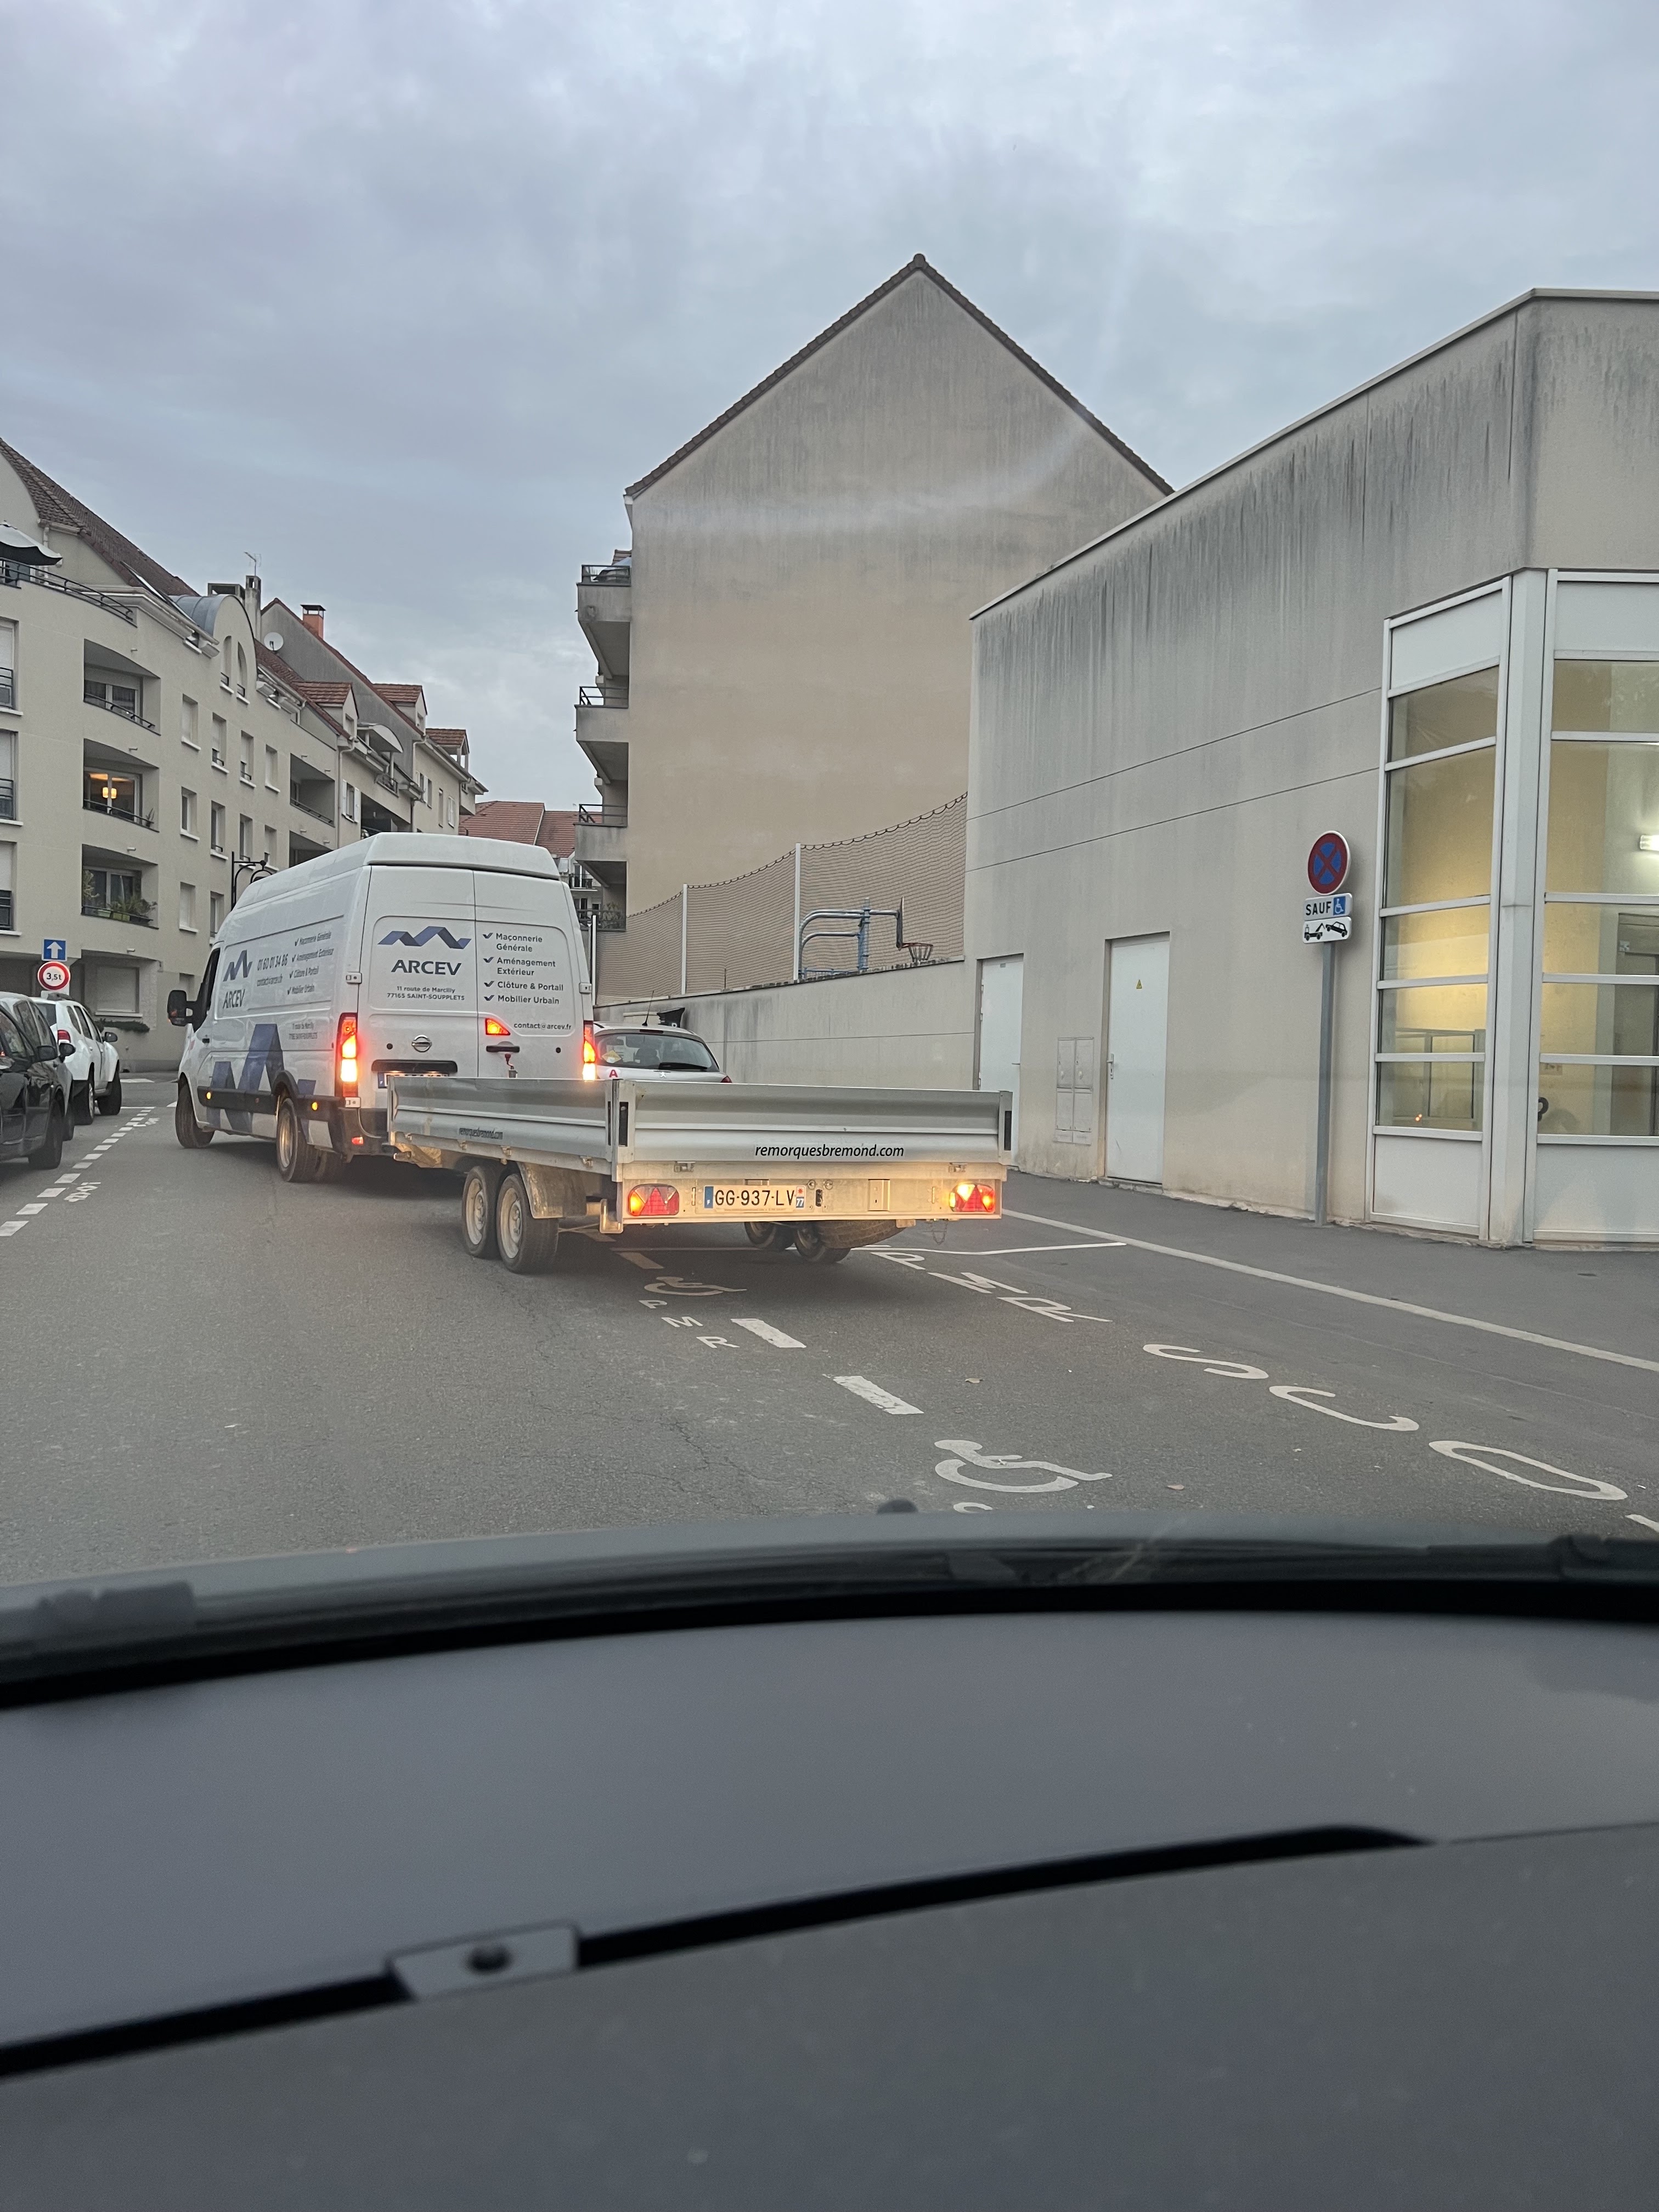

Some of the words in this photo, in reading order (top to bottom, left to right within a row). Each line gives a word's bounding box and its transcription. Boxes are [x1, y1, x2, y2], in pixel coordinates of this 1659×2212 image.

[1305, 901, 1331, 916] SAUF
[496, 933, 543, 943] Maçonnerie
[496, 943, 533, 952] Générale
[496, 957, 556, 967] Aménagement
[391, 960, 462, 975] ARCEV
[497, 967, 534, 976] Extérieur
[497, 981, 528, 989] Clôture
[223, 989, 246, 1009] ARCEV
[498, 995, 531, 1003] Mobilier
[533, 996, 560, 1005] Urbain
[609, 1069, 618, 1078] A
[754, 1144, 904, 1159] remorquesbremond.com
[714, 1190, 795, 1206] GG-937-LV
[795, 1198, 805, 1207] 77
